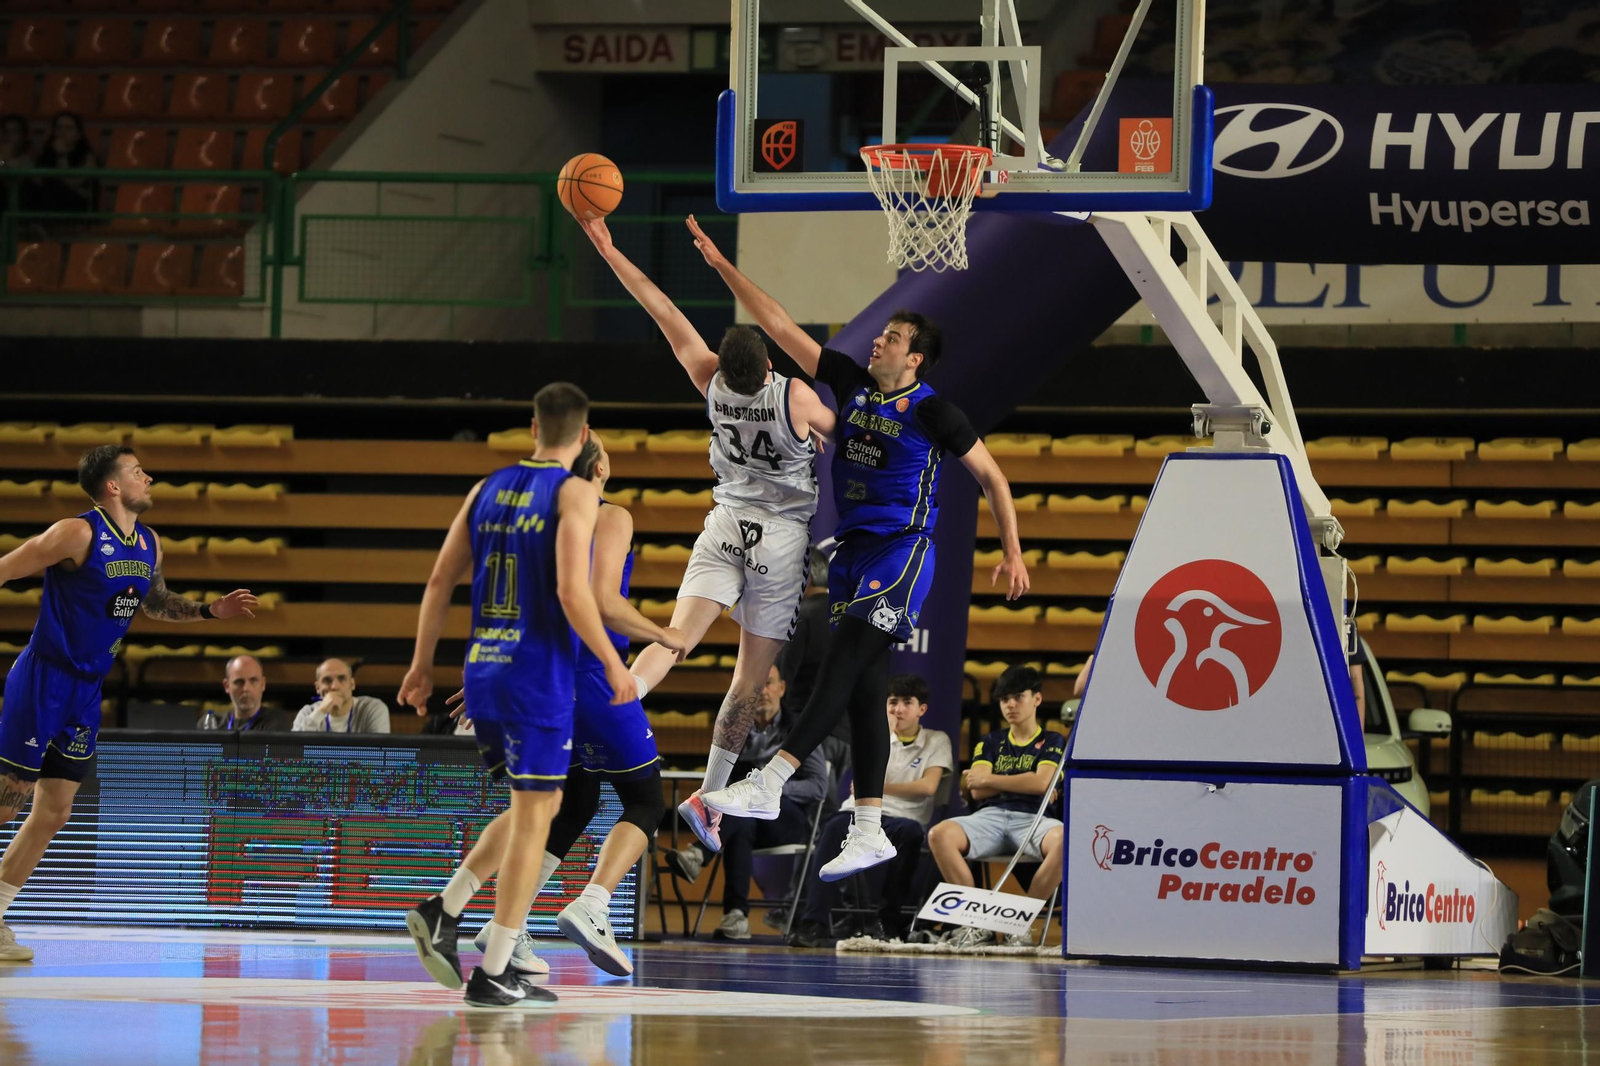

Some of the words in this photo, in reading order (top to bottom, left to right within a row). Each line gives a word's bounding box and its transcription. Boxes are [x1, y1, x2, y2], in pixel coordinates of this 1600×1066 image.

[563, 33, 674, 63] SAIDA
[1369, 192, 1591, 233] Hyupersa
[720, 423, 783, 470] 34
[845, 448, 877, 467] Galicia
[846, 438, 882, 458] Estrella
[481, 551, 521, 619] 11
[1157, 874, 1316, 906] Paradelo
[1386, 880, 1475, 923] BricoCentro
